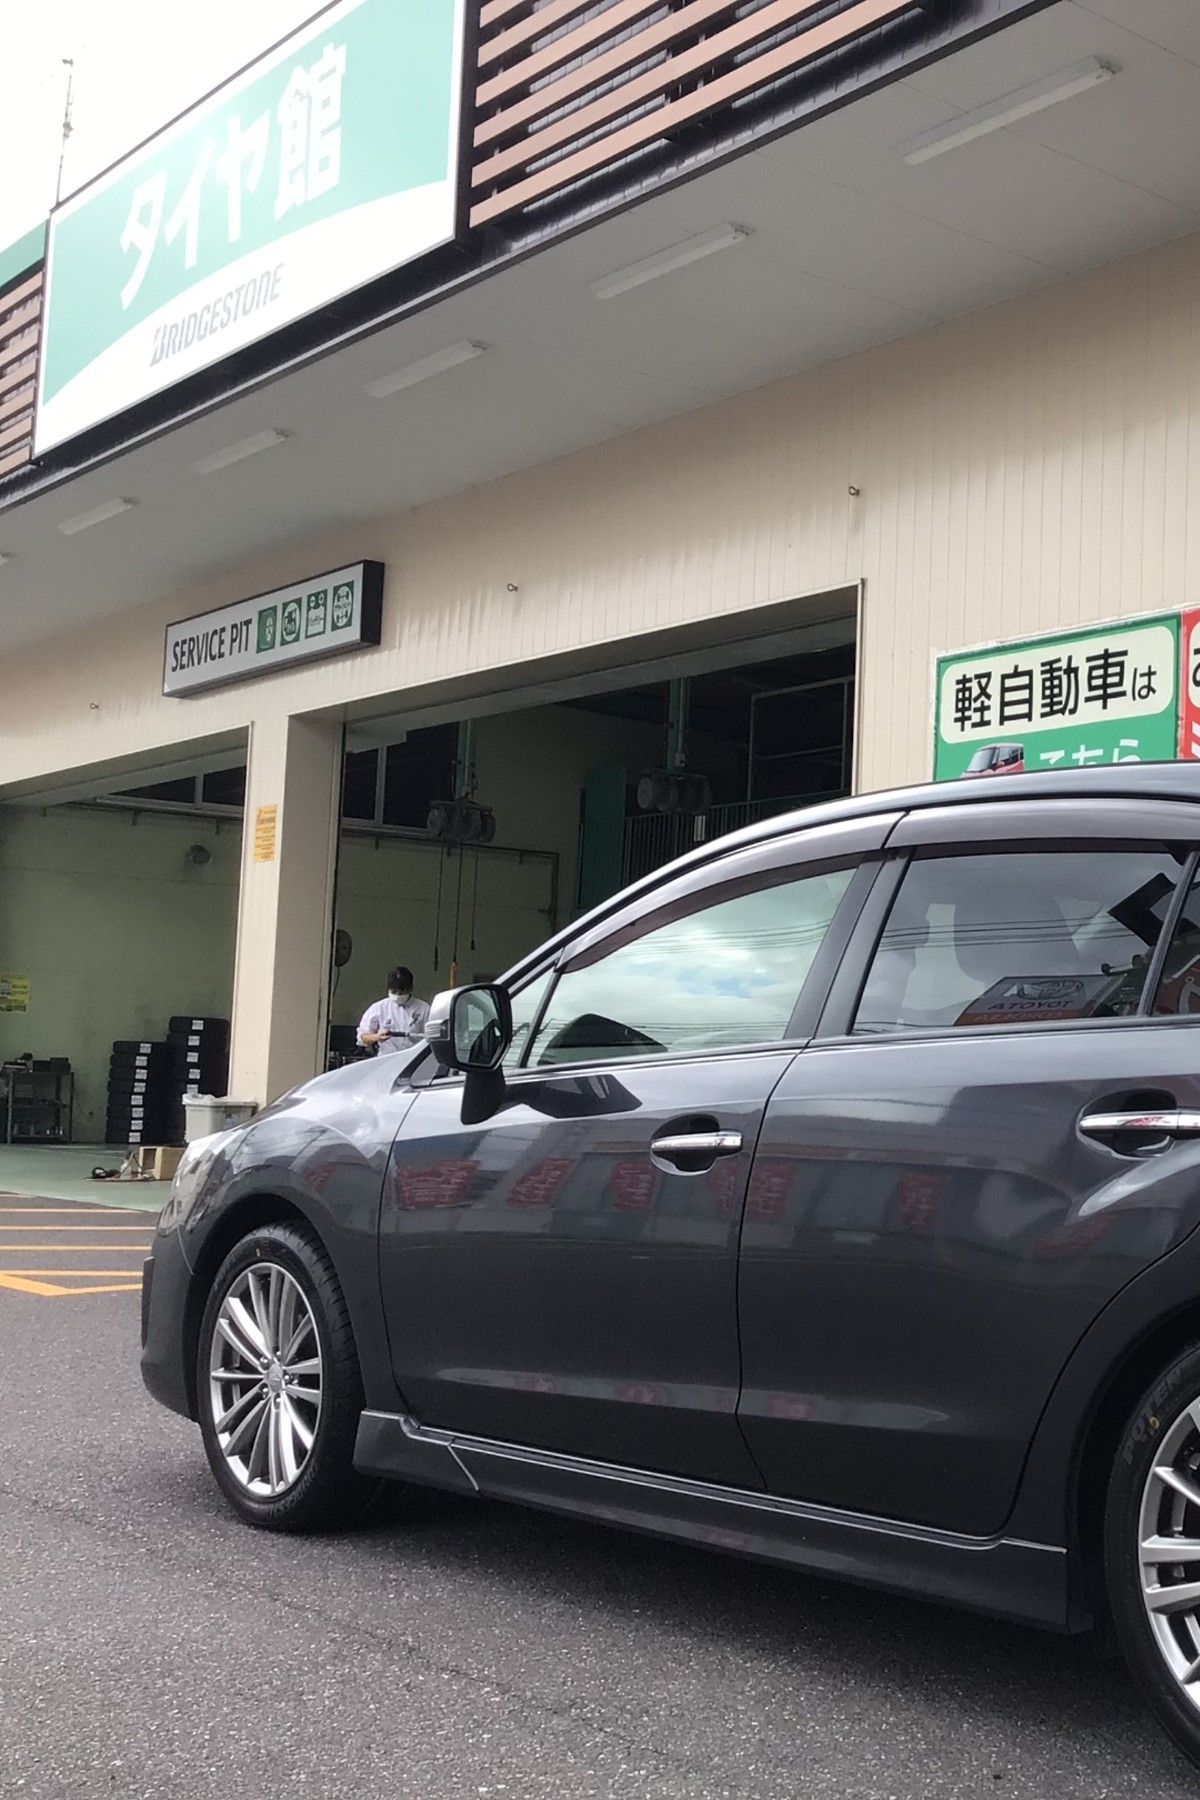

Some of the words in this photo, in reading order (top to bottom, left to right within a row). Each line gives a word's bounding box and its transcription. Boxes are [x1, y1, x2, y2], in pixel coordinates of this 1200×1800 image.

[119, 41, 347, 312] タイヤ館
[150, 262, 284, 368] BRIDGESTONE
[171, 625, 226, 672] SERVICE
[230, 618, 252, 656] PIT
[953, 648, 1157, 732] 軽自動車は
